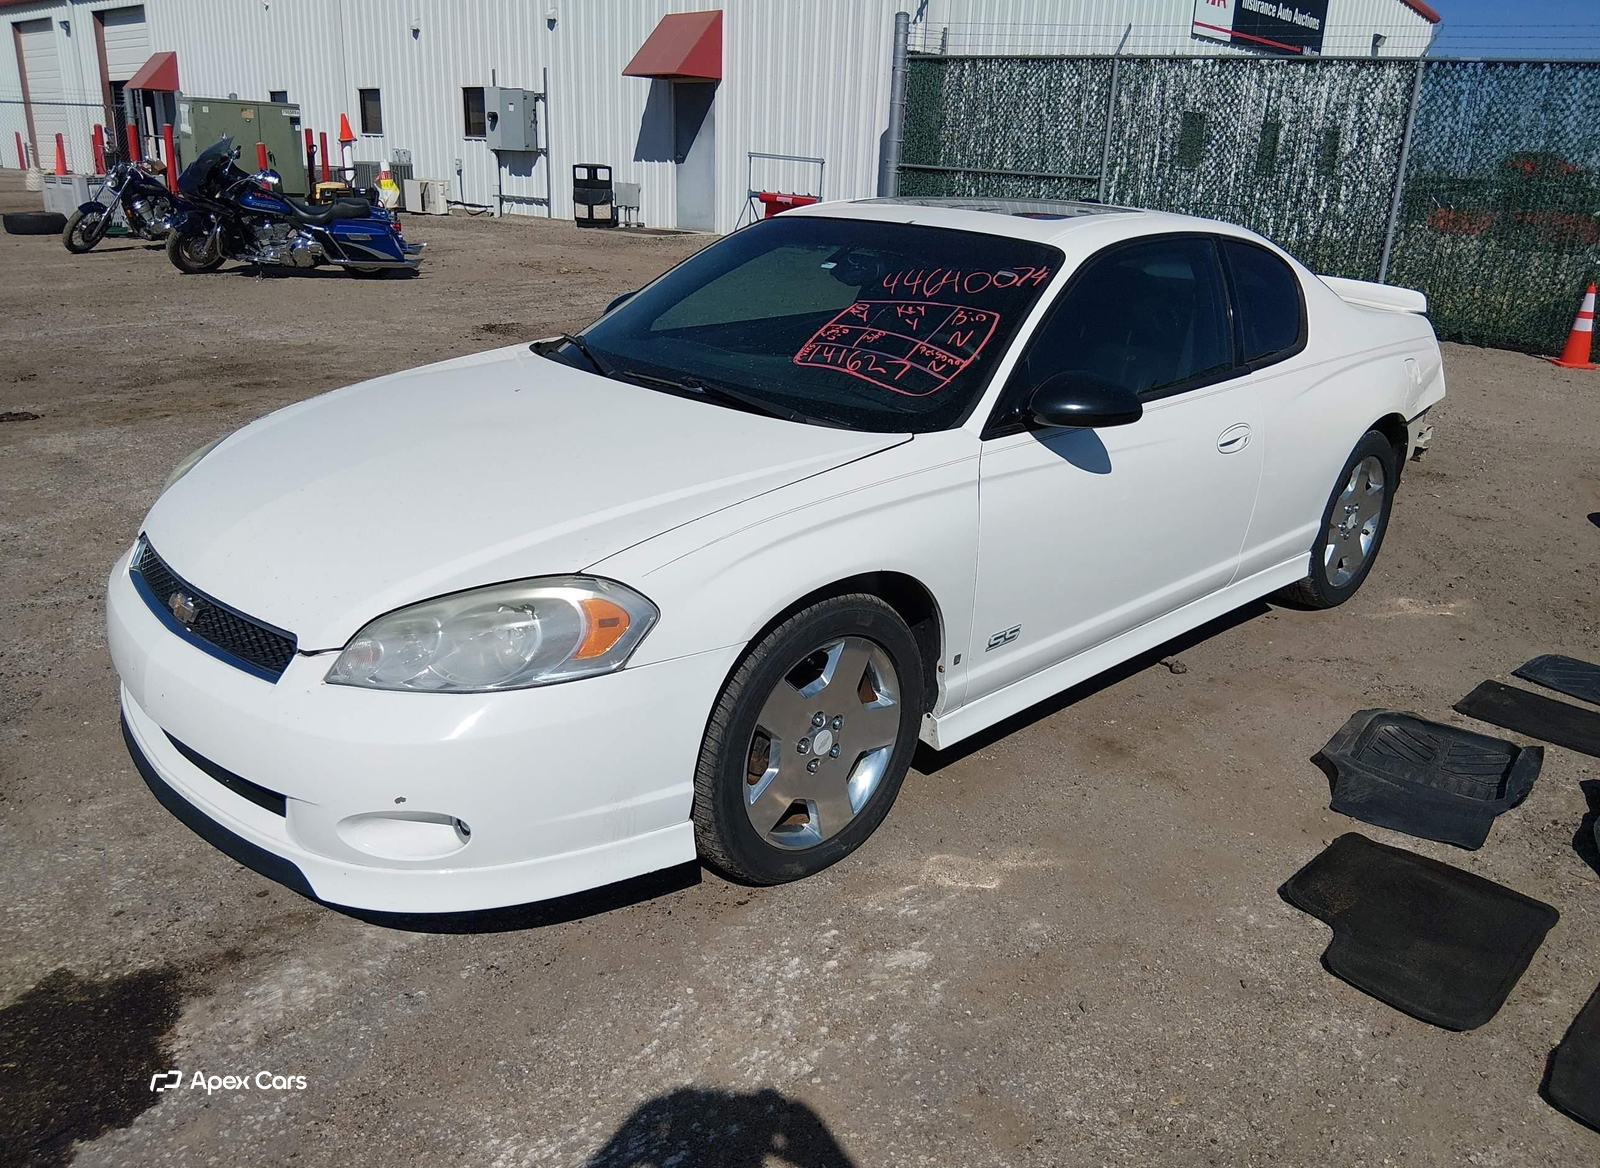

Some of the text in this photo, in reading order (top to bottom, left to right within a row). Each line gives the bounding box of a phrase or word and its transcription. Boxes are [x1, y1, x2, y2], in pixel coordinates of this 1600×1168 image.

[1242, 0, 1277, 17] Insurance
[1278, 3, 1293, 22] Auto
[1293, 8, 1320, 30] Auctions
[947, 330, 974, 347] N
[985, 623, 1022, 652] SS
